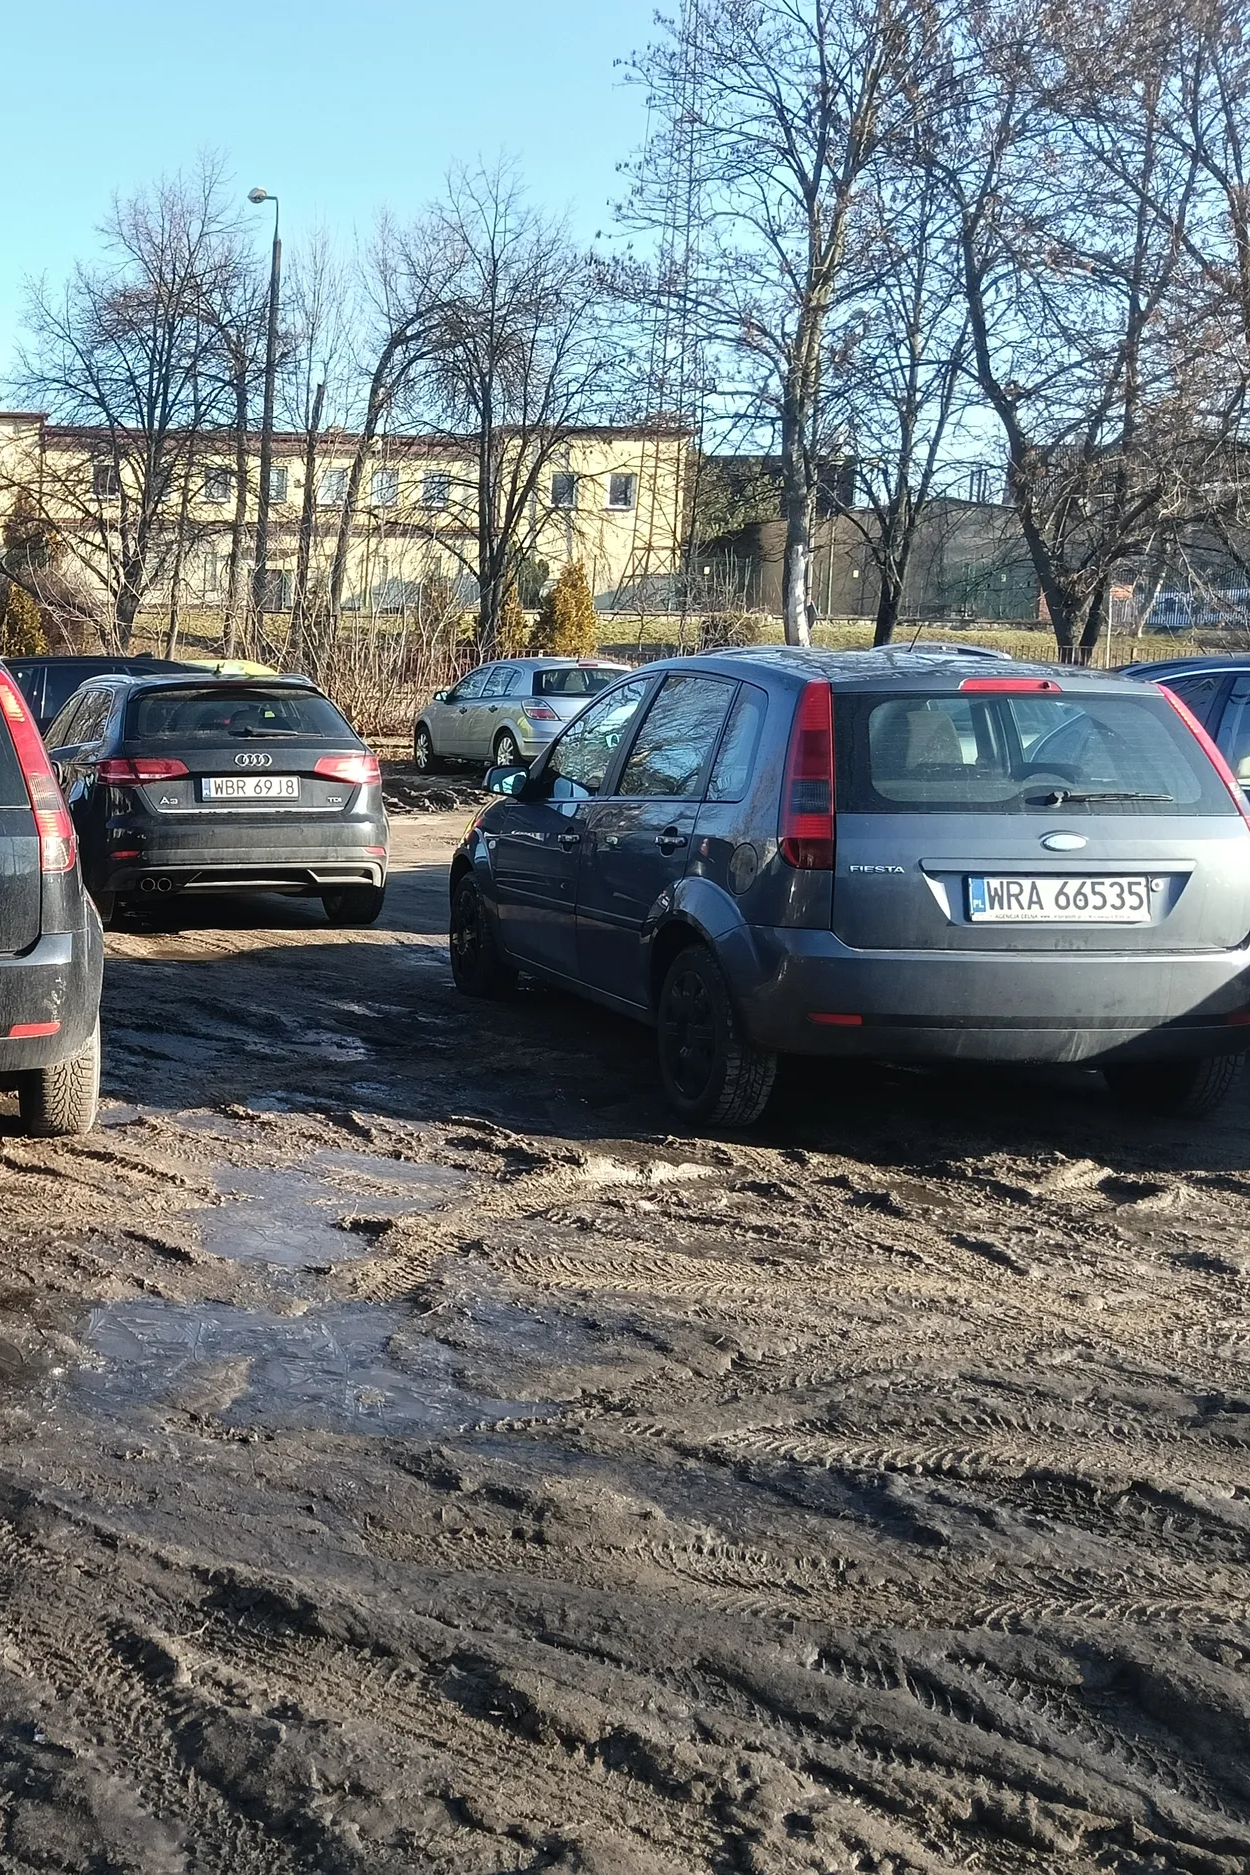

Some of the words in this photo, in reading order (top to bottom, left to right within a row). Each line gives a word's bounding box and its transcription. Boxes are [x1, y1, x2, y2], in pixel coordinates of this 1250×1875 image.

[214, 779, 246, 796] WBR
[253, 779, 295, 795] 69J8
[159, 796, 179, 805] A3
[849, 865, 905, 874] FIESTA
[986, 881, 1044, 910] WRA
[1054, 881, 1145, 911] 66535
[973, 899, 985, 908] PL
